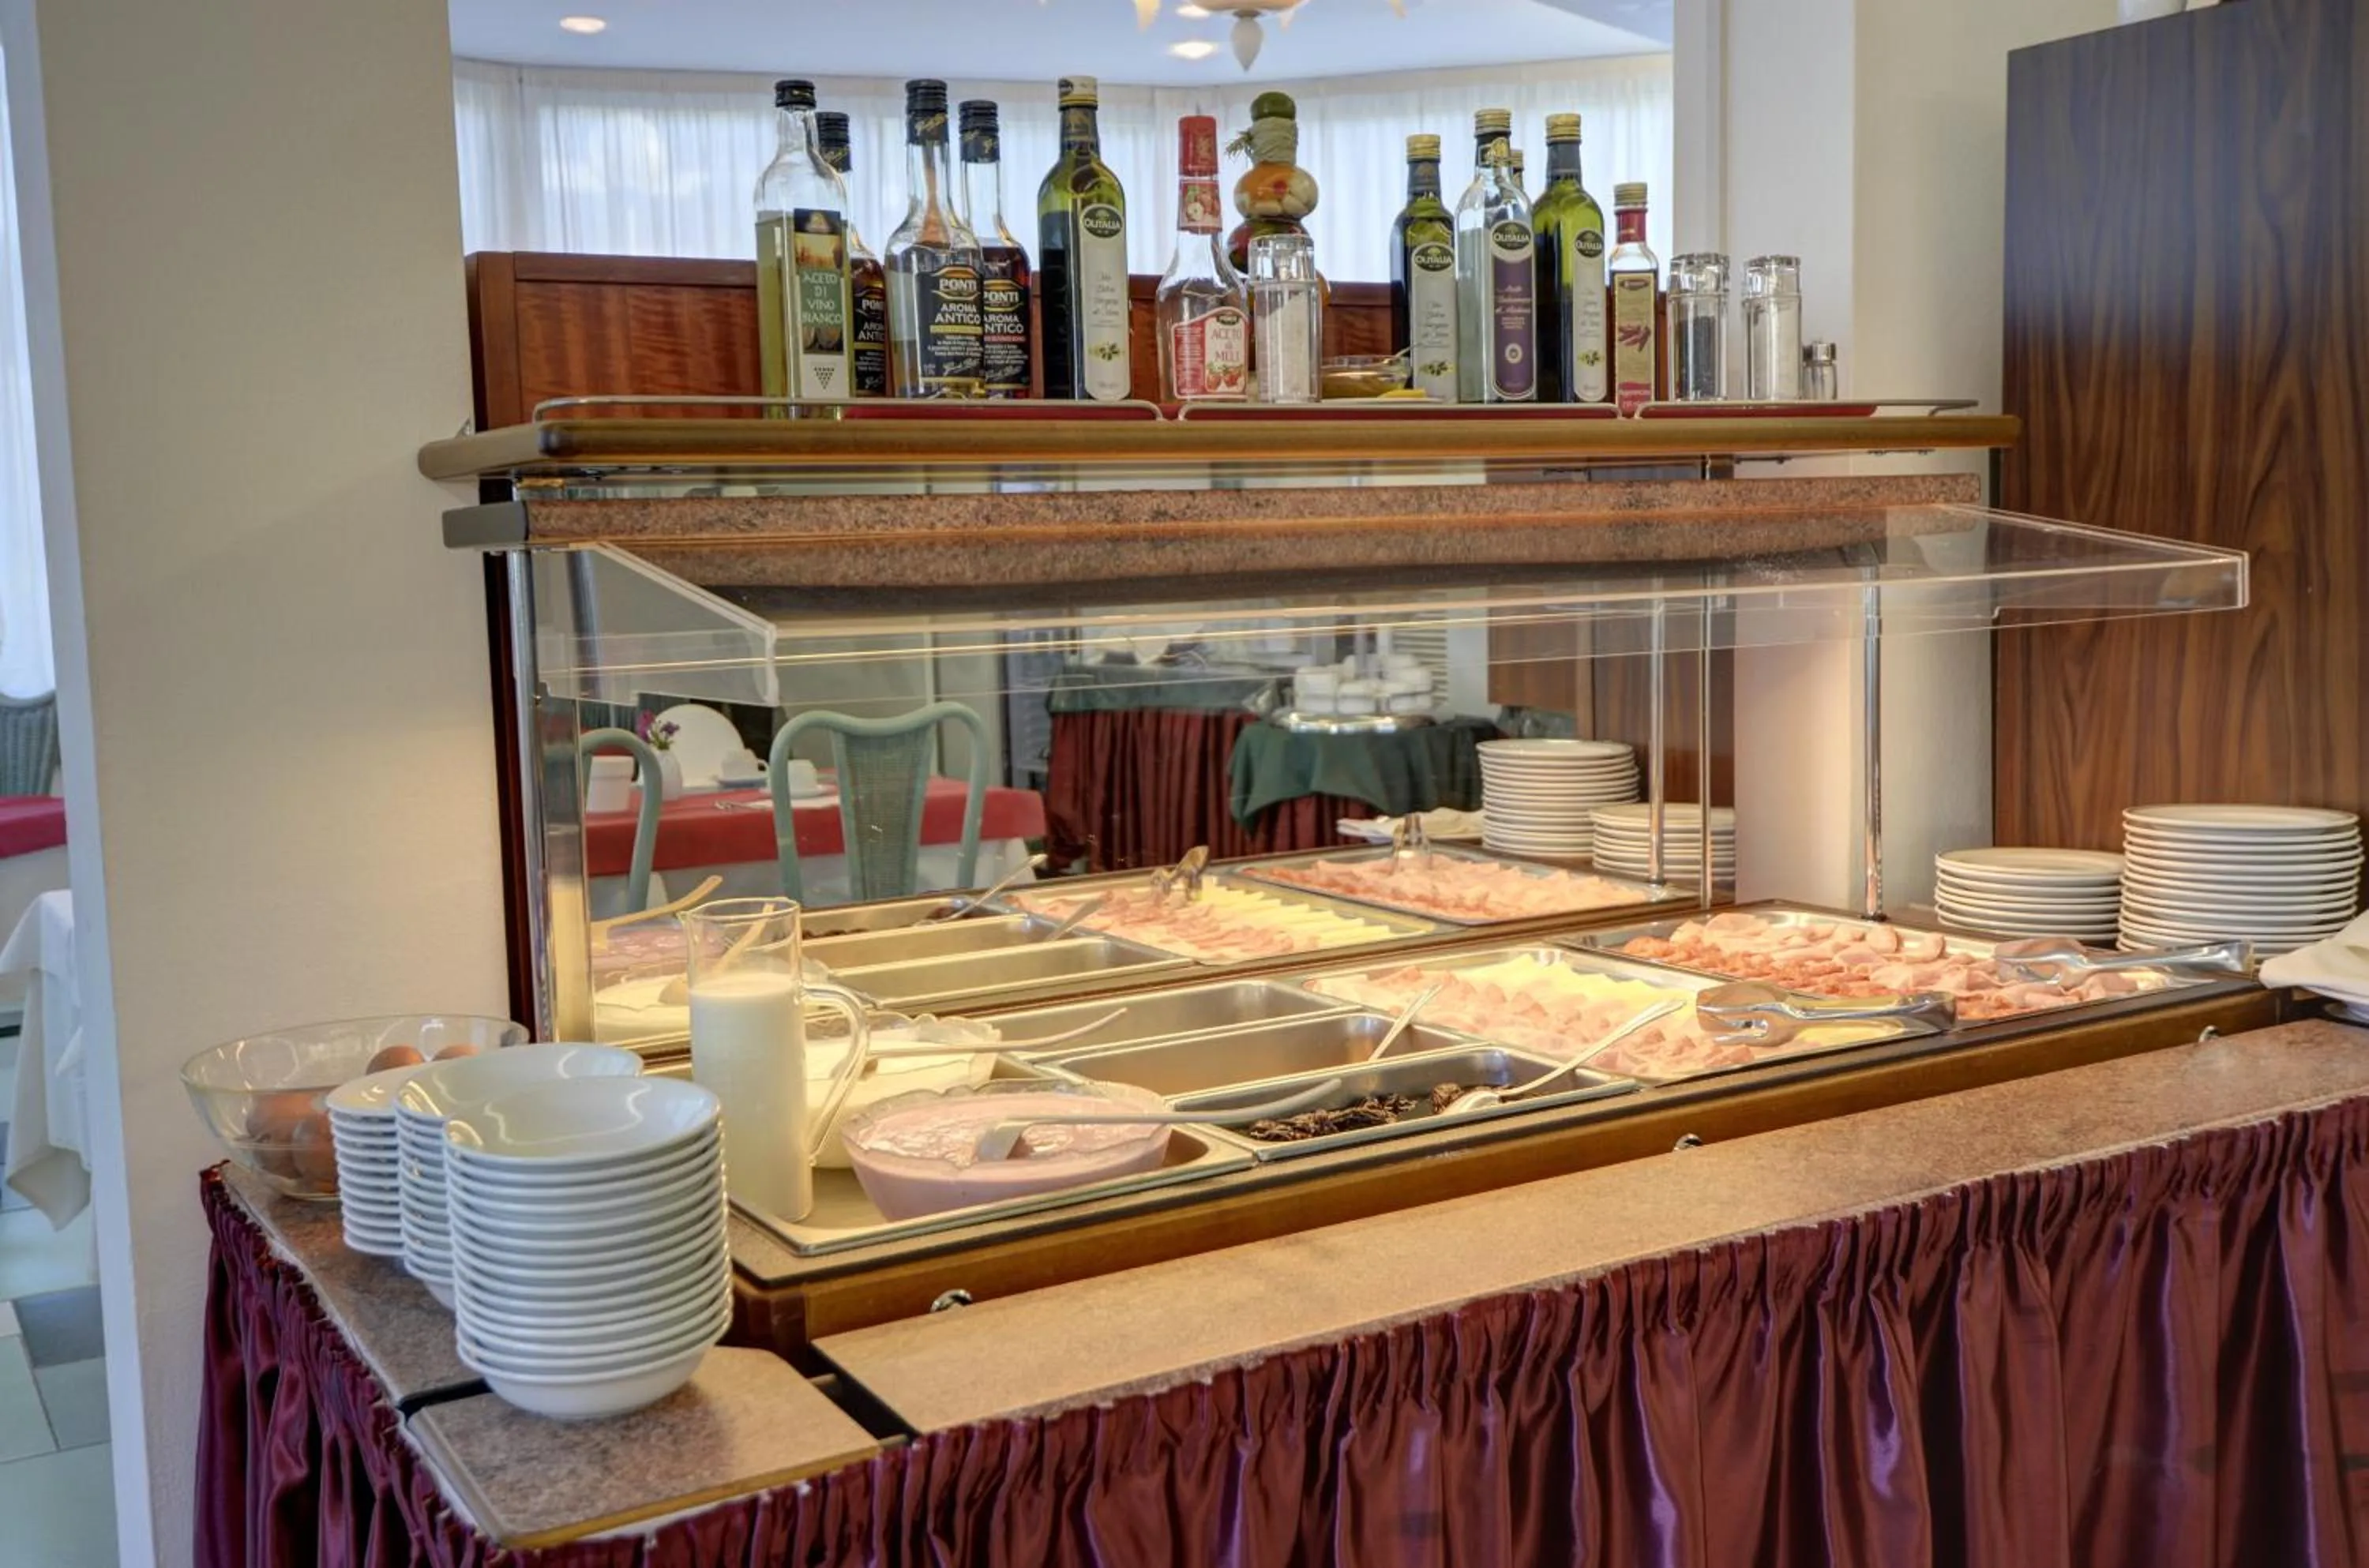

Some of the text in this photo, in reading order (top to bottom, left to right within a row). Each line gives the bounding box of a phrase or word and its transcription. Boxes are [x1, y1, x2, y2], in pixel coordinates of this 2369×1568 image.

[802, 272, 838, 284] ACETO
[939, 279, 977, 291] PONTI
[814, 286, 827, 297] DI
[807, 298, 835, 310] VINO
[940, 303, 977, 313] AROMA
[802, 313, 843, 324] BIANCO
[935, 313, 981, 324] ANTICO
[985, 323, 1024, 334] NTICO
